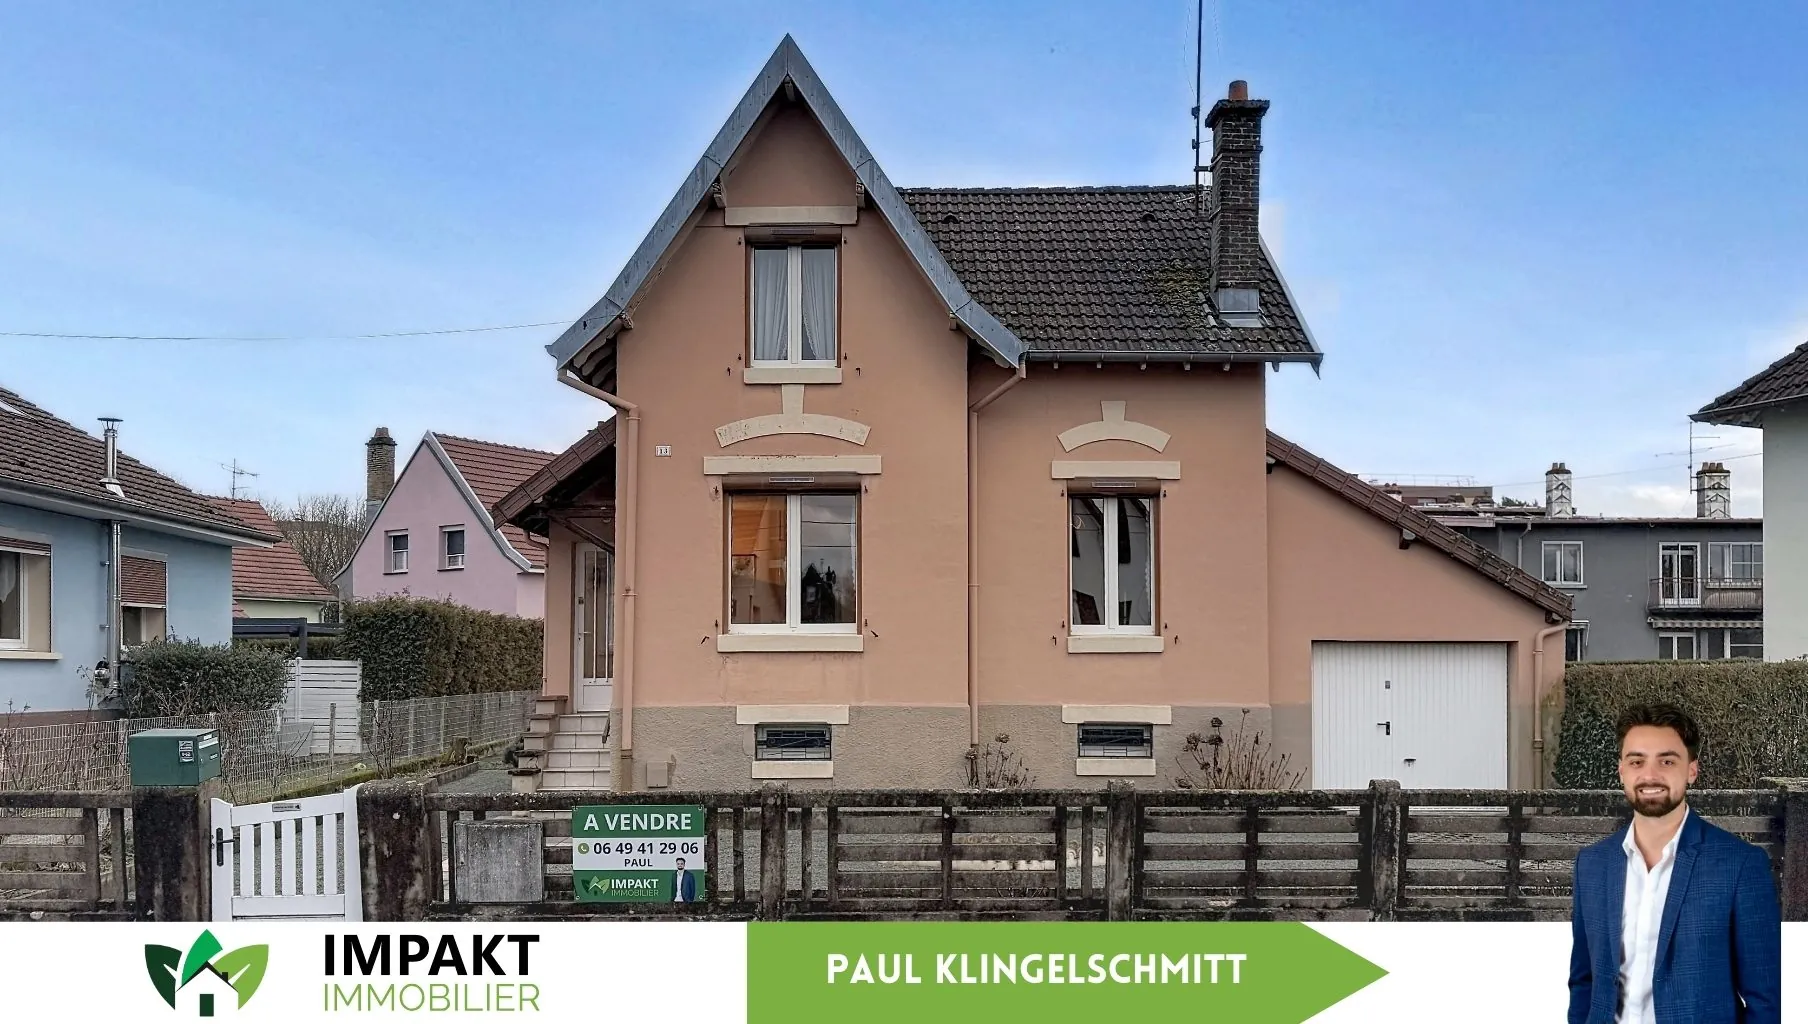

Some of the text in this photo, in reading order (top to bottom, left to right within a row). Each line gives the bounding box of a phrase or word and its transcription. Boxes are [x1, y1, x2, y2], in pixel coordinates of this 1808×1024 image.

[583, 813, 692, 831] A VENDRE
[593, 842, 699, 854] 06 49 41 29 06
[624, 858, 653, 867] PAUL
[611, 878, 659, 889] IMPAKT
[611, 889, 659, 897] IMMOBILIER
